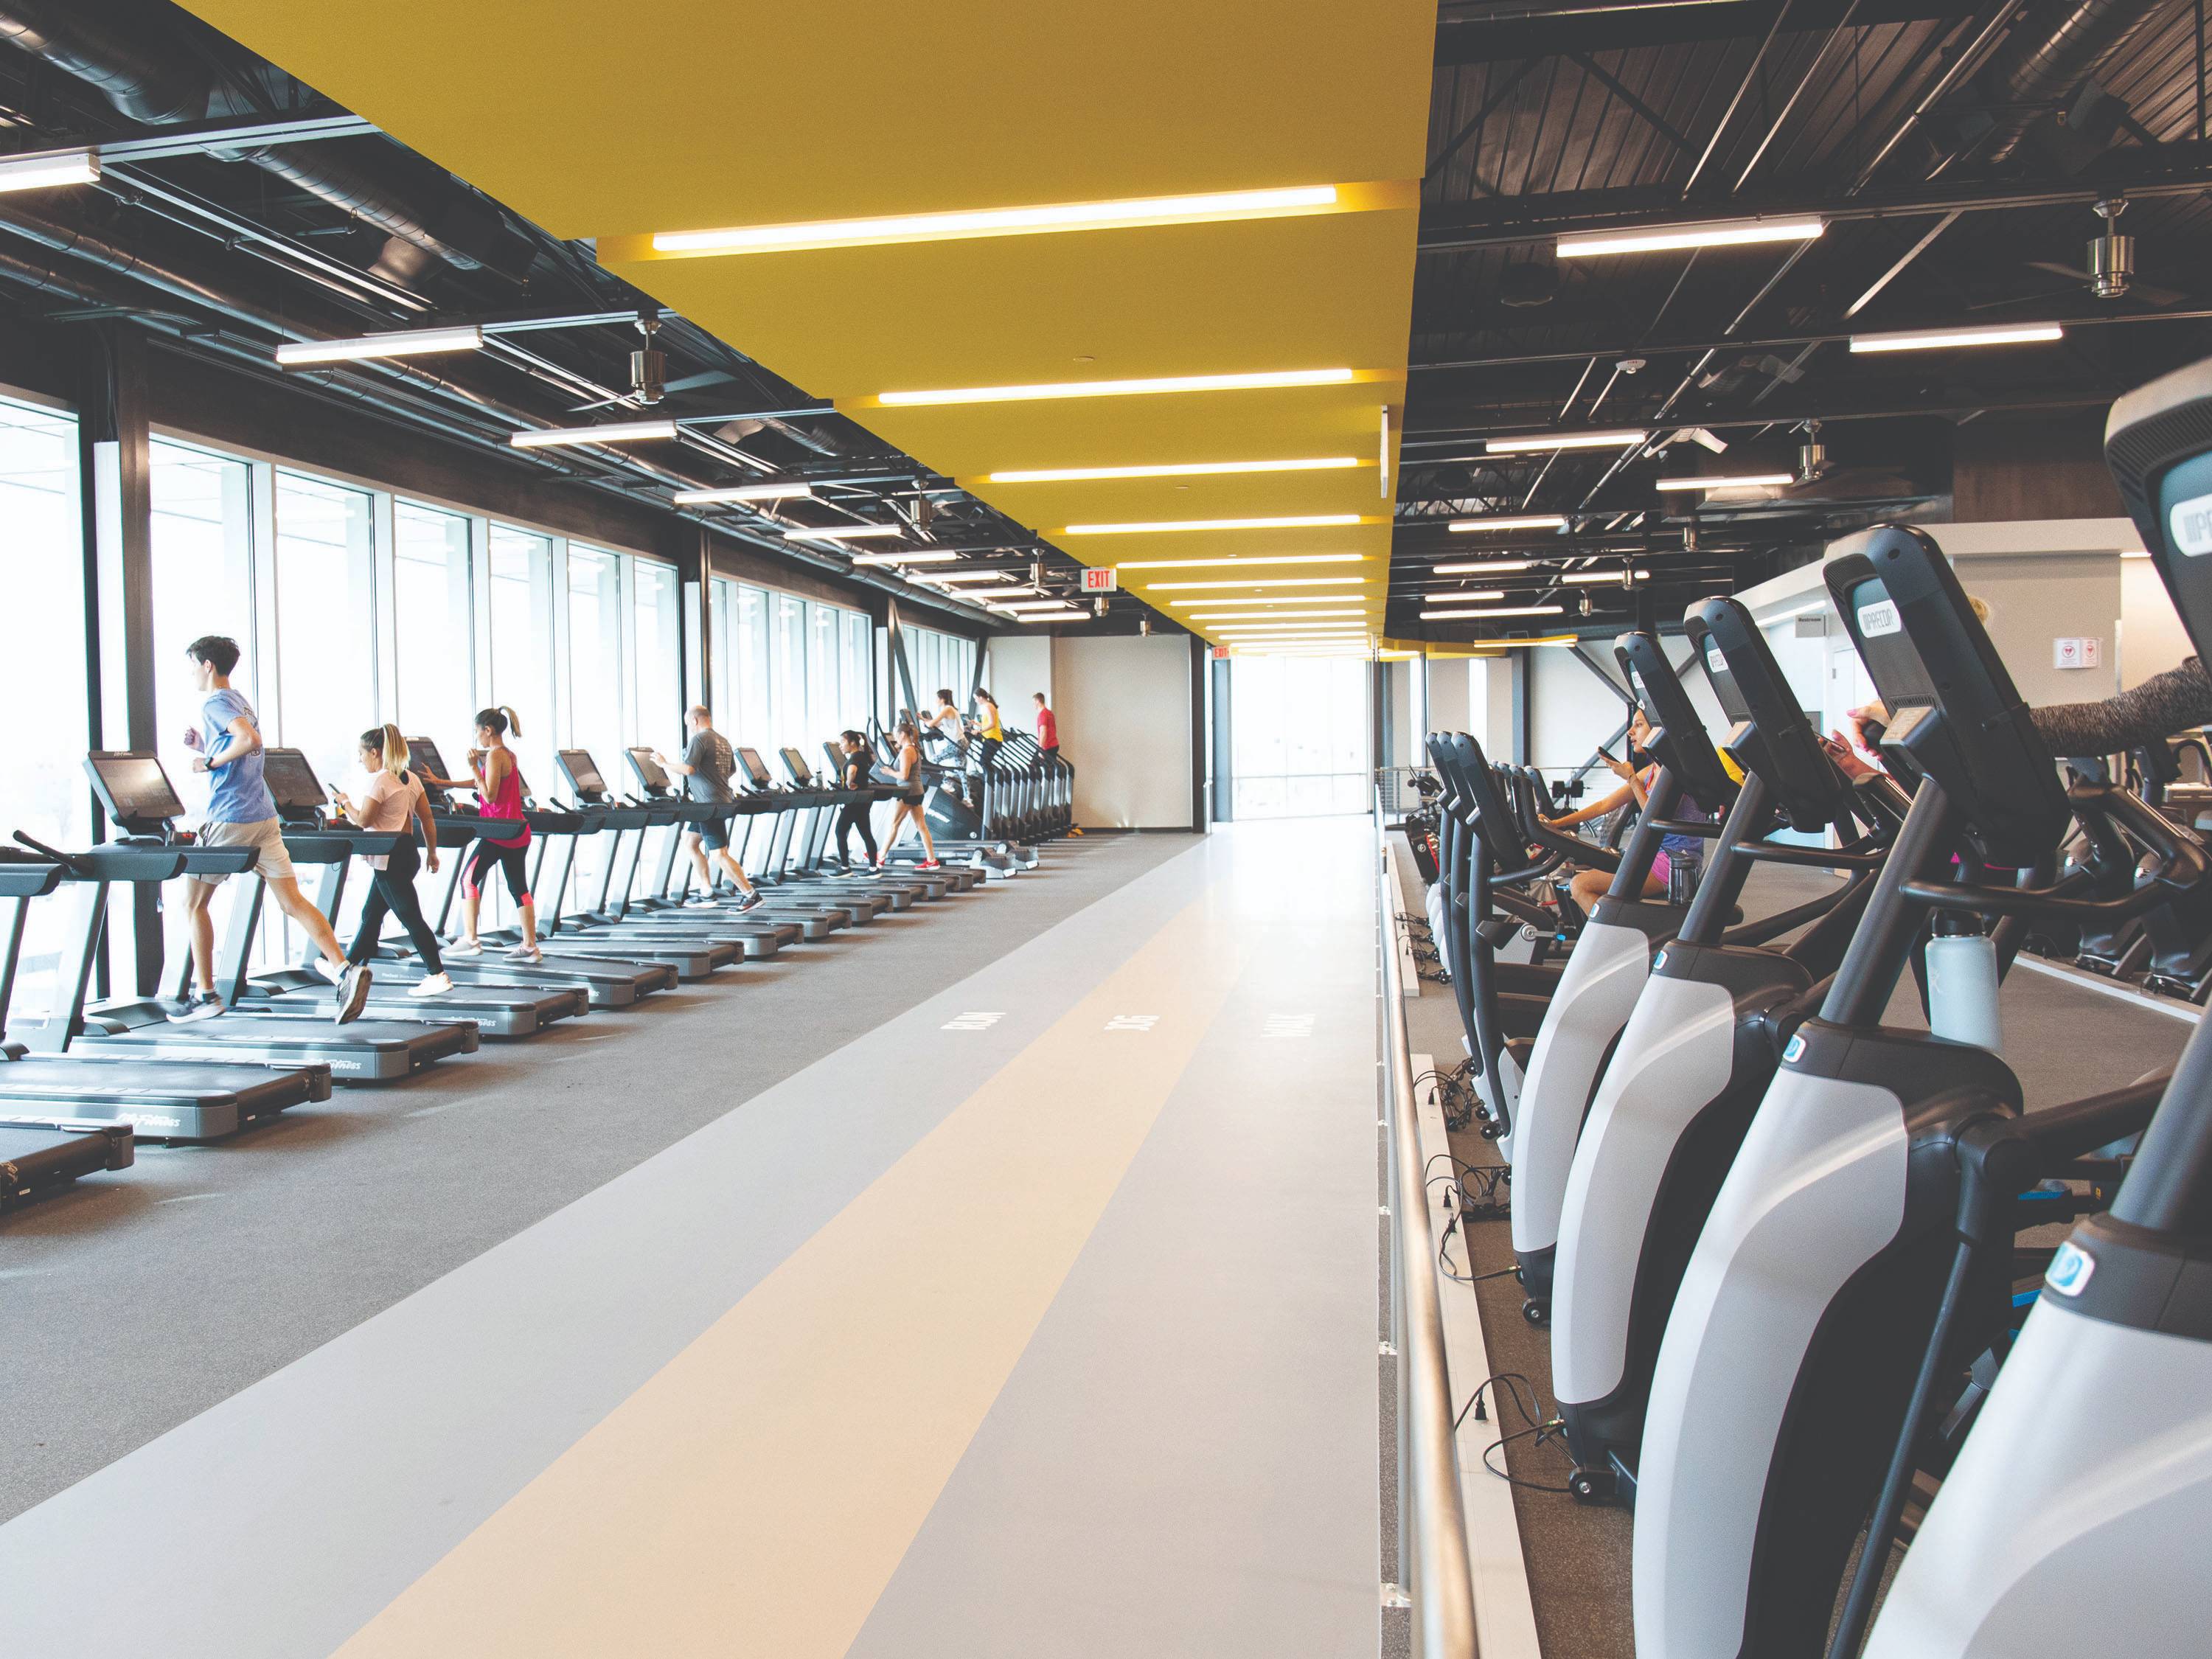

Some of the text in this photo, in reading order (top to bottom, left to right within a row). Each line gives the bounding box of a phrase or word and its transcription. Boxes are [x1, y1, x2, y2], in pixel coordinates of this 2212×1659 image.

[1088, 571, 1110, 588] EXIT
[1214, 648, 1228, 658] EXIT
[939, 1012, 1006, 1030] RUN
[1104, 1015, 1160, 1032] JOG
[1261, 1013, 1315, 1037] WALK
